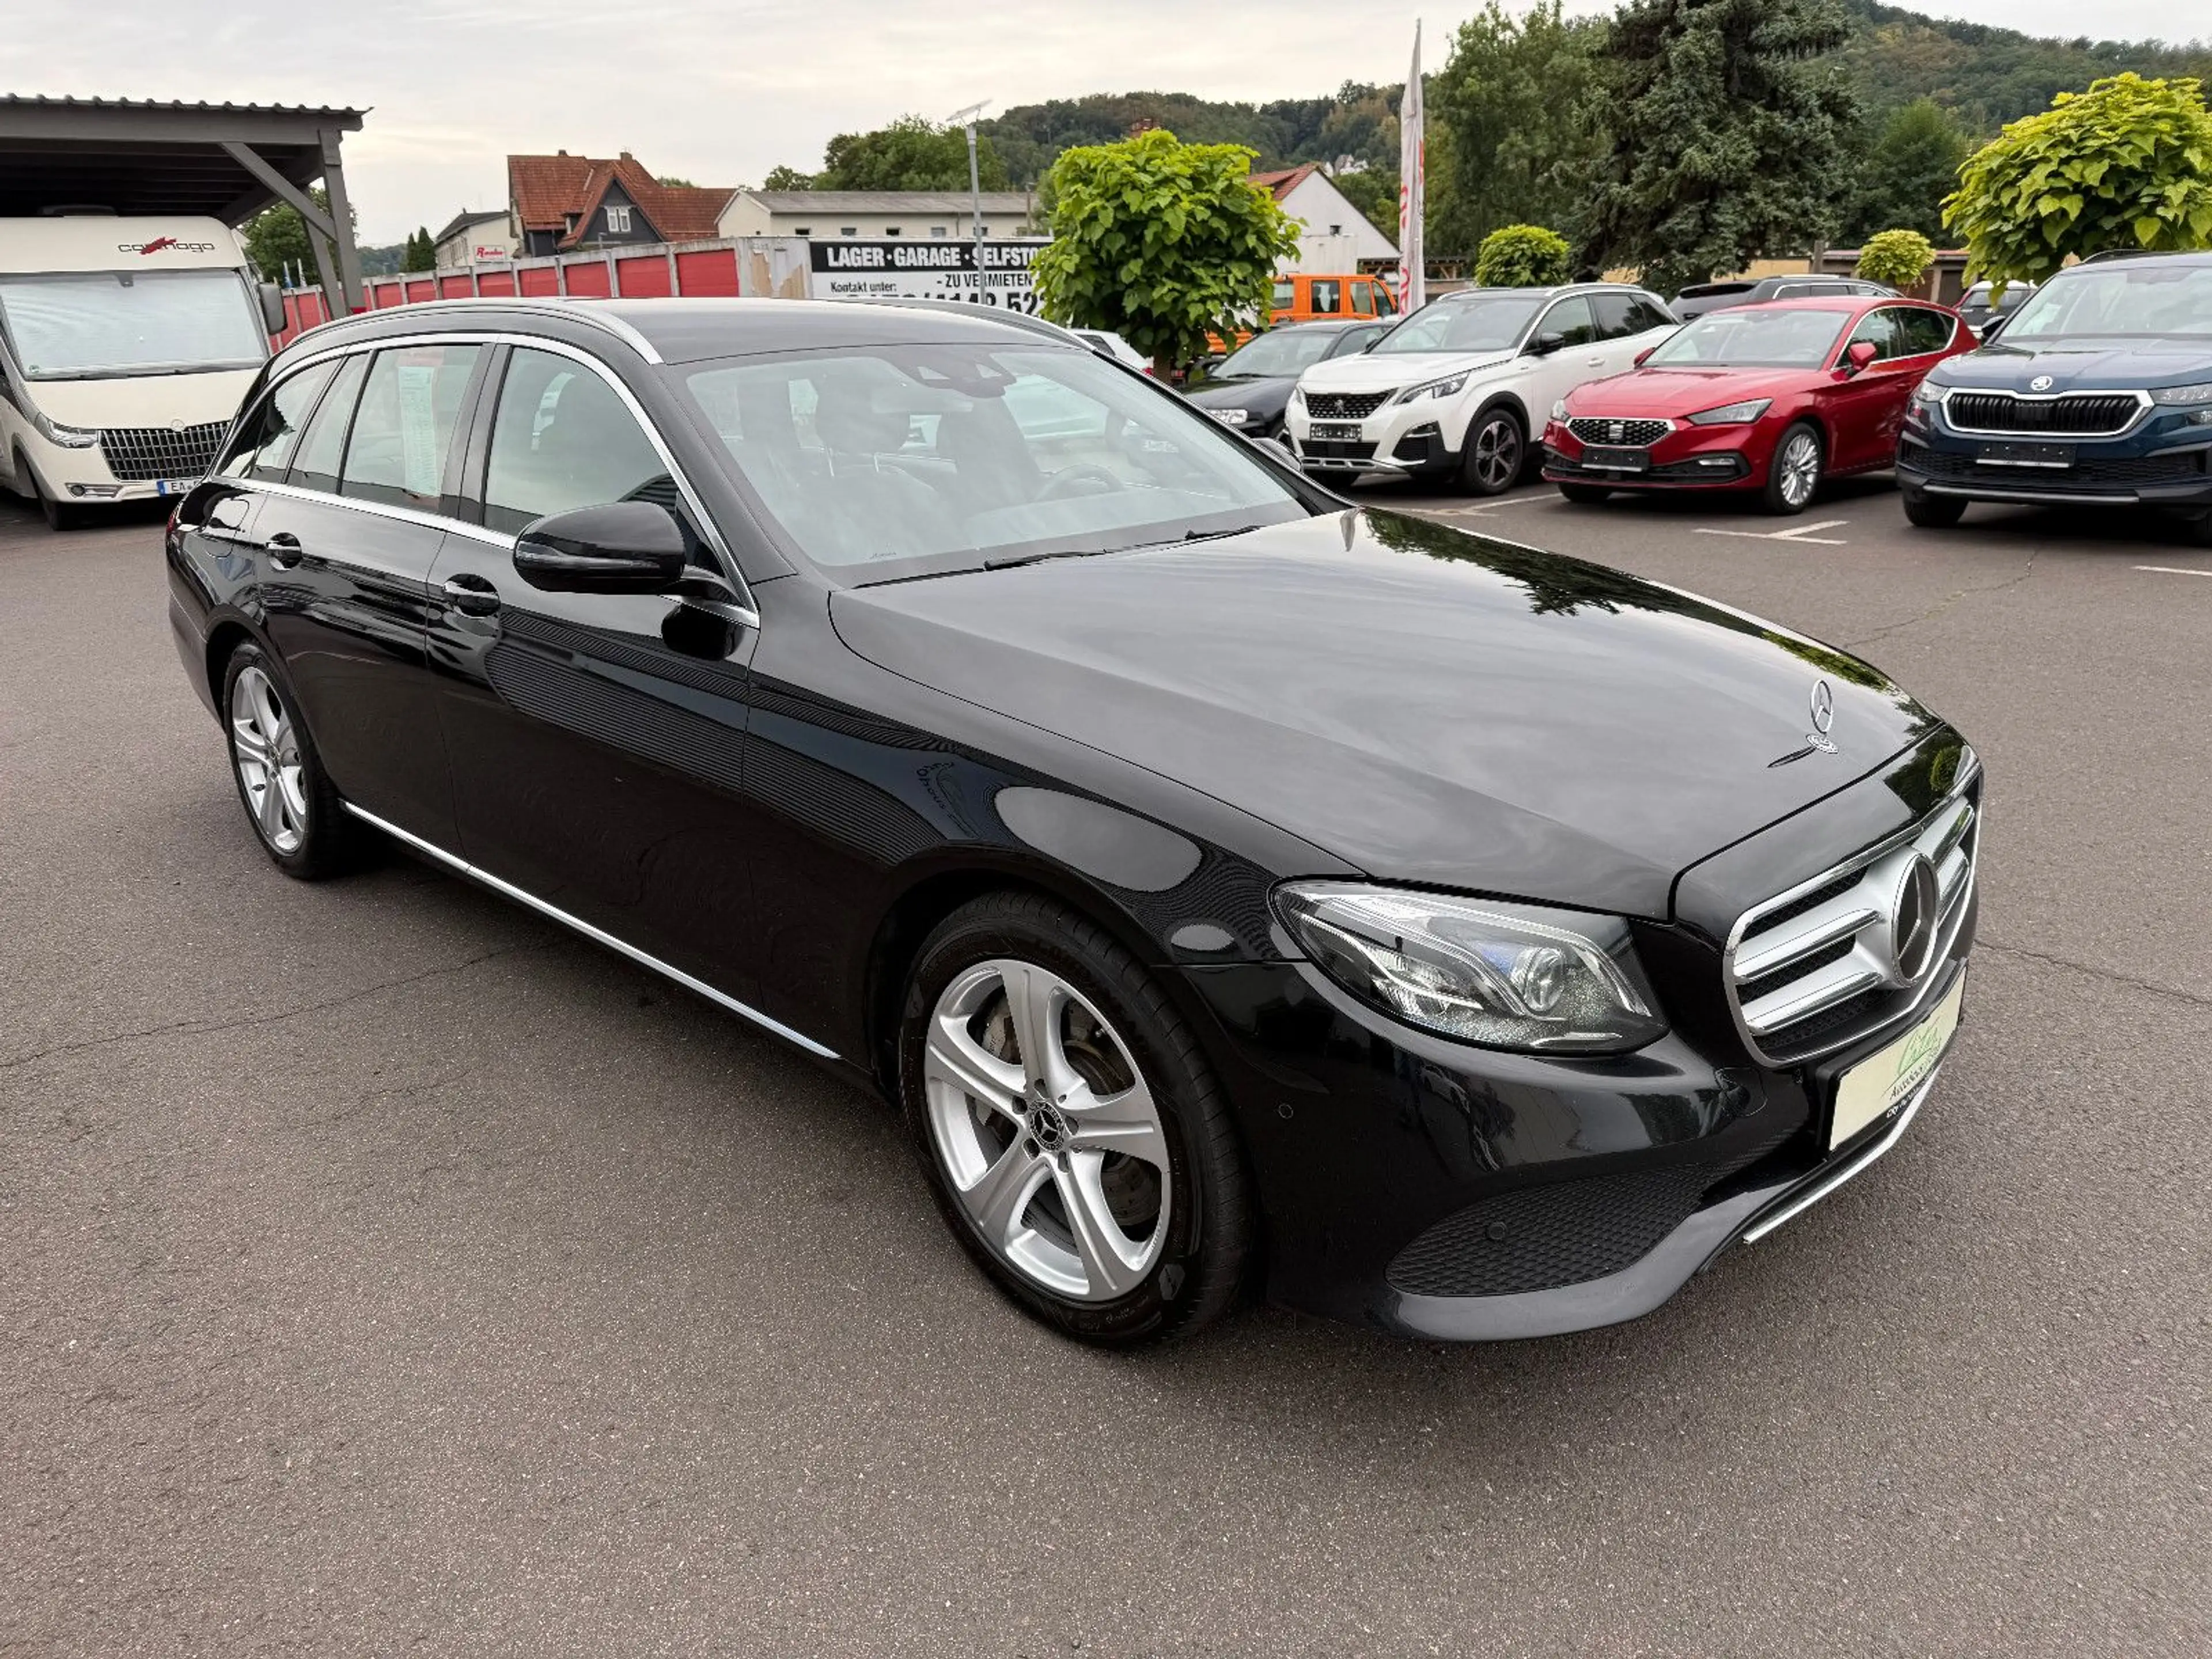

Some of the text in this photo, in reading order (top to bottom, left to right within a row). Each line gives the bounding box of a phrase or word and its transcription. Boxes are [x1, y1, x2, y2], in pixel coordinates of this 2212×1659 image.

[827, 247, 885, 267] LAGER
[894, 247, 961, 267] GARAGE
[830, 281, 897, 292] Kontakt unter:
[945, 274, 1032, 287] ZU VEMIETEN
